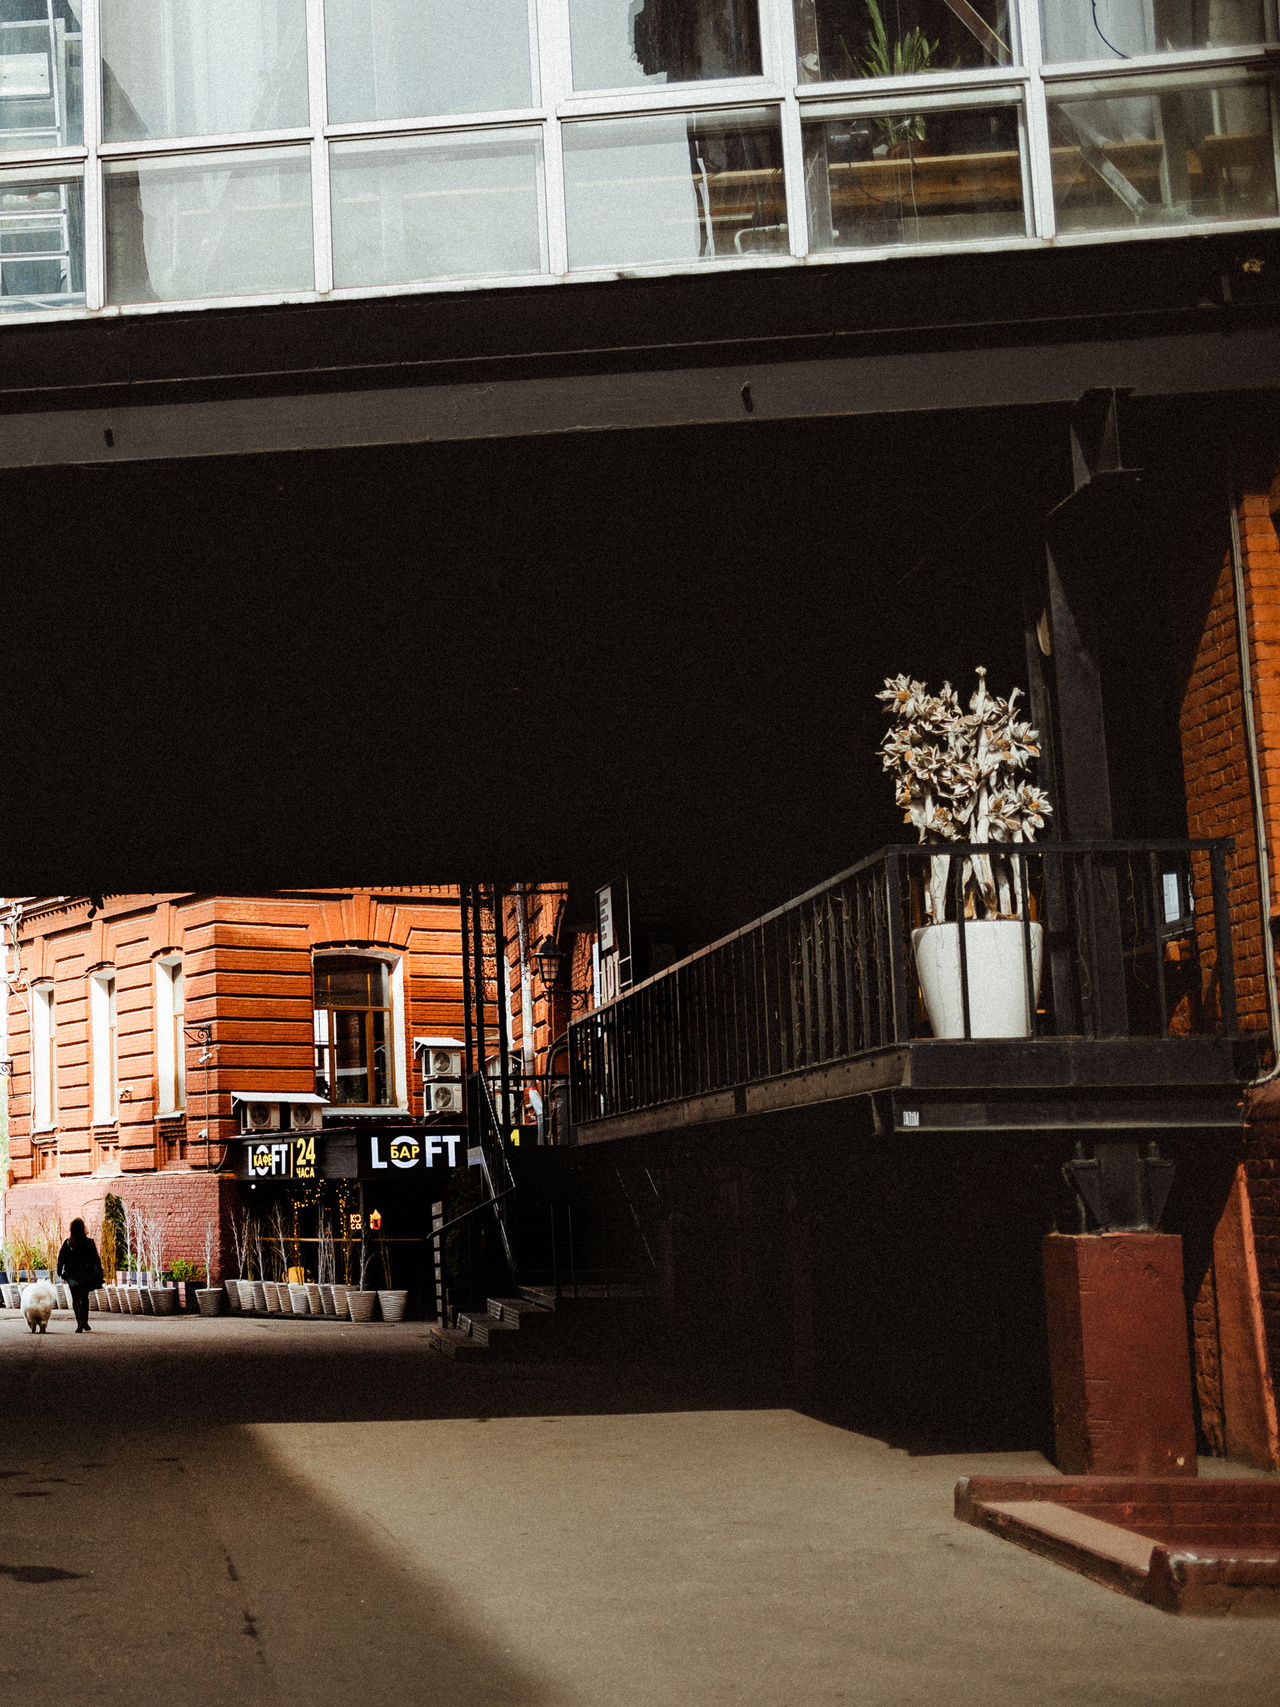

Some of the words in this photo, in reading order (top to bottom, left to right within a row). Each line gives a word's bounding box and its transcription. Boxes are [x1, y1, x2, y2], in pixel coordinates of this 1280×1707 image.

[248, 1144, 288, 1176] LOFT
[253, 1153, 273, 1167] КАФЕ
[296, 1137, 316, 1166] 24
[371, 1135, 461, 1169] LOFT
[390, 1145, 420, 1159] БАР
[296, 1166, 315, 1178] ЧАСА
